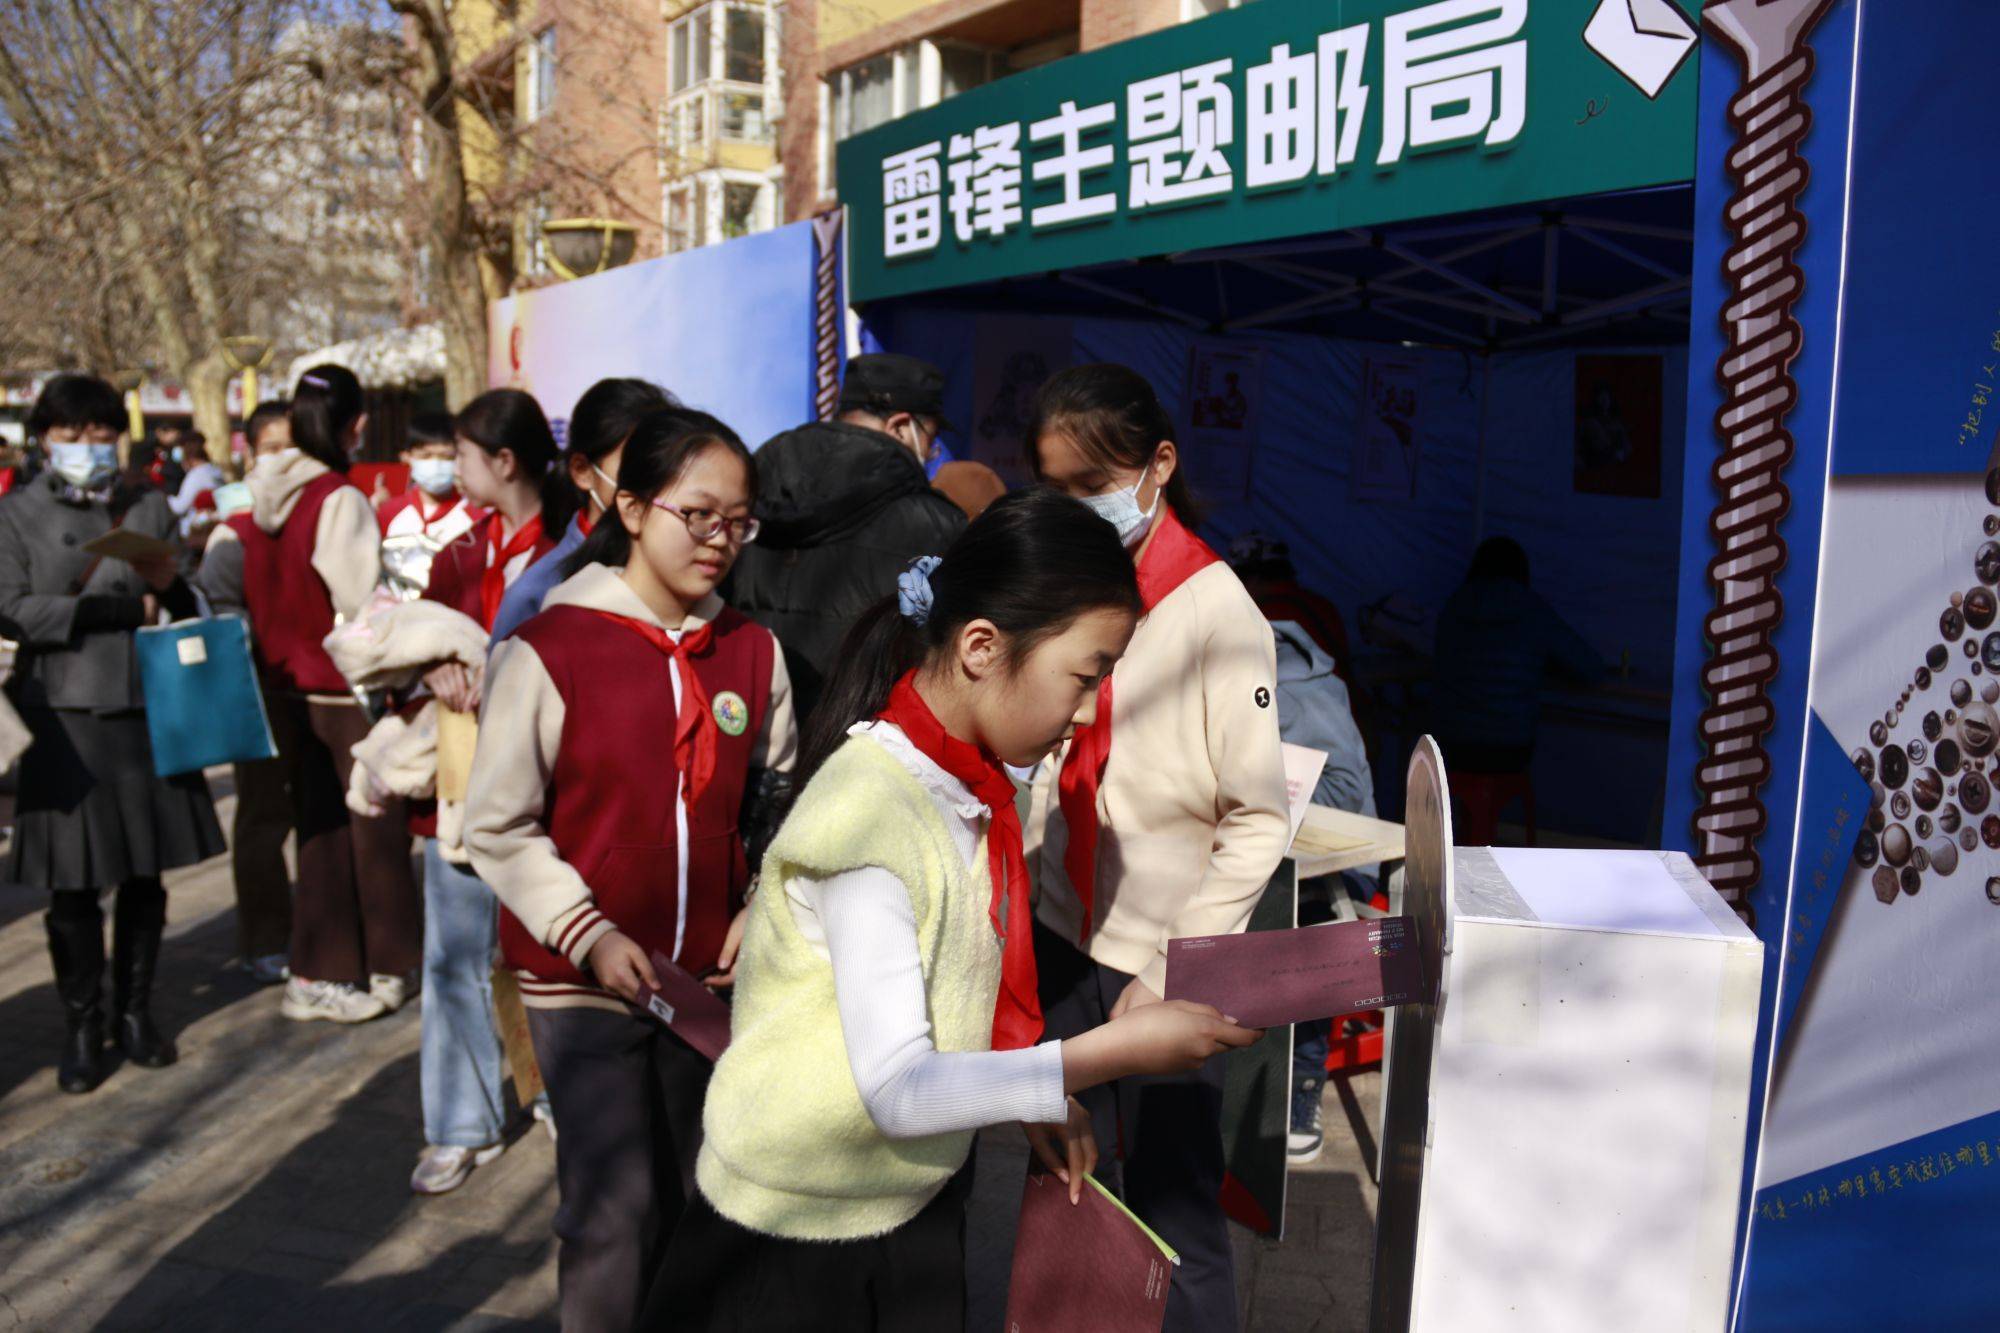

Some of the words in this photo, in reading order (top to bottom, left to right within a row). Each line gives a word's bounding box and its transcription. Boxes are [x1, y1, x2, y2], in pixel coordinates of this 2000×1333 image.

[882, 0, 1528, 257] 雷锋主题邮局
